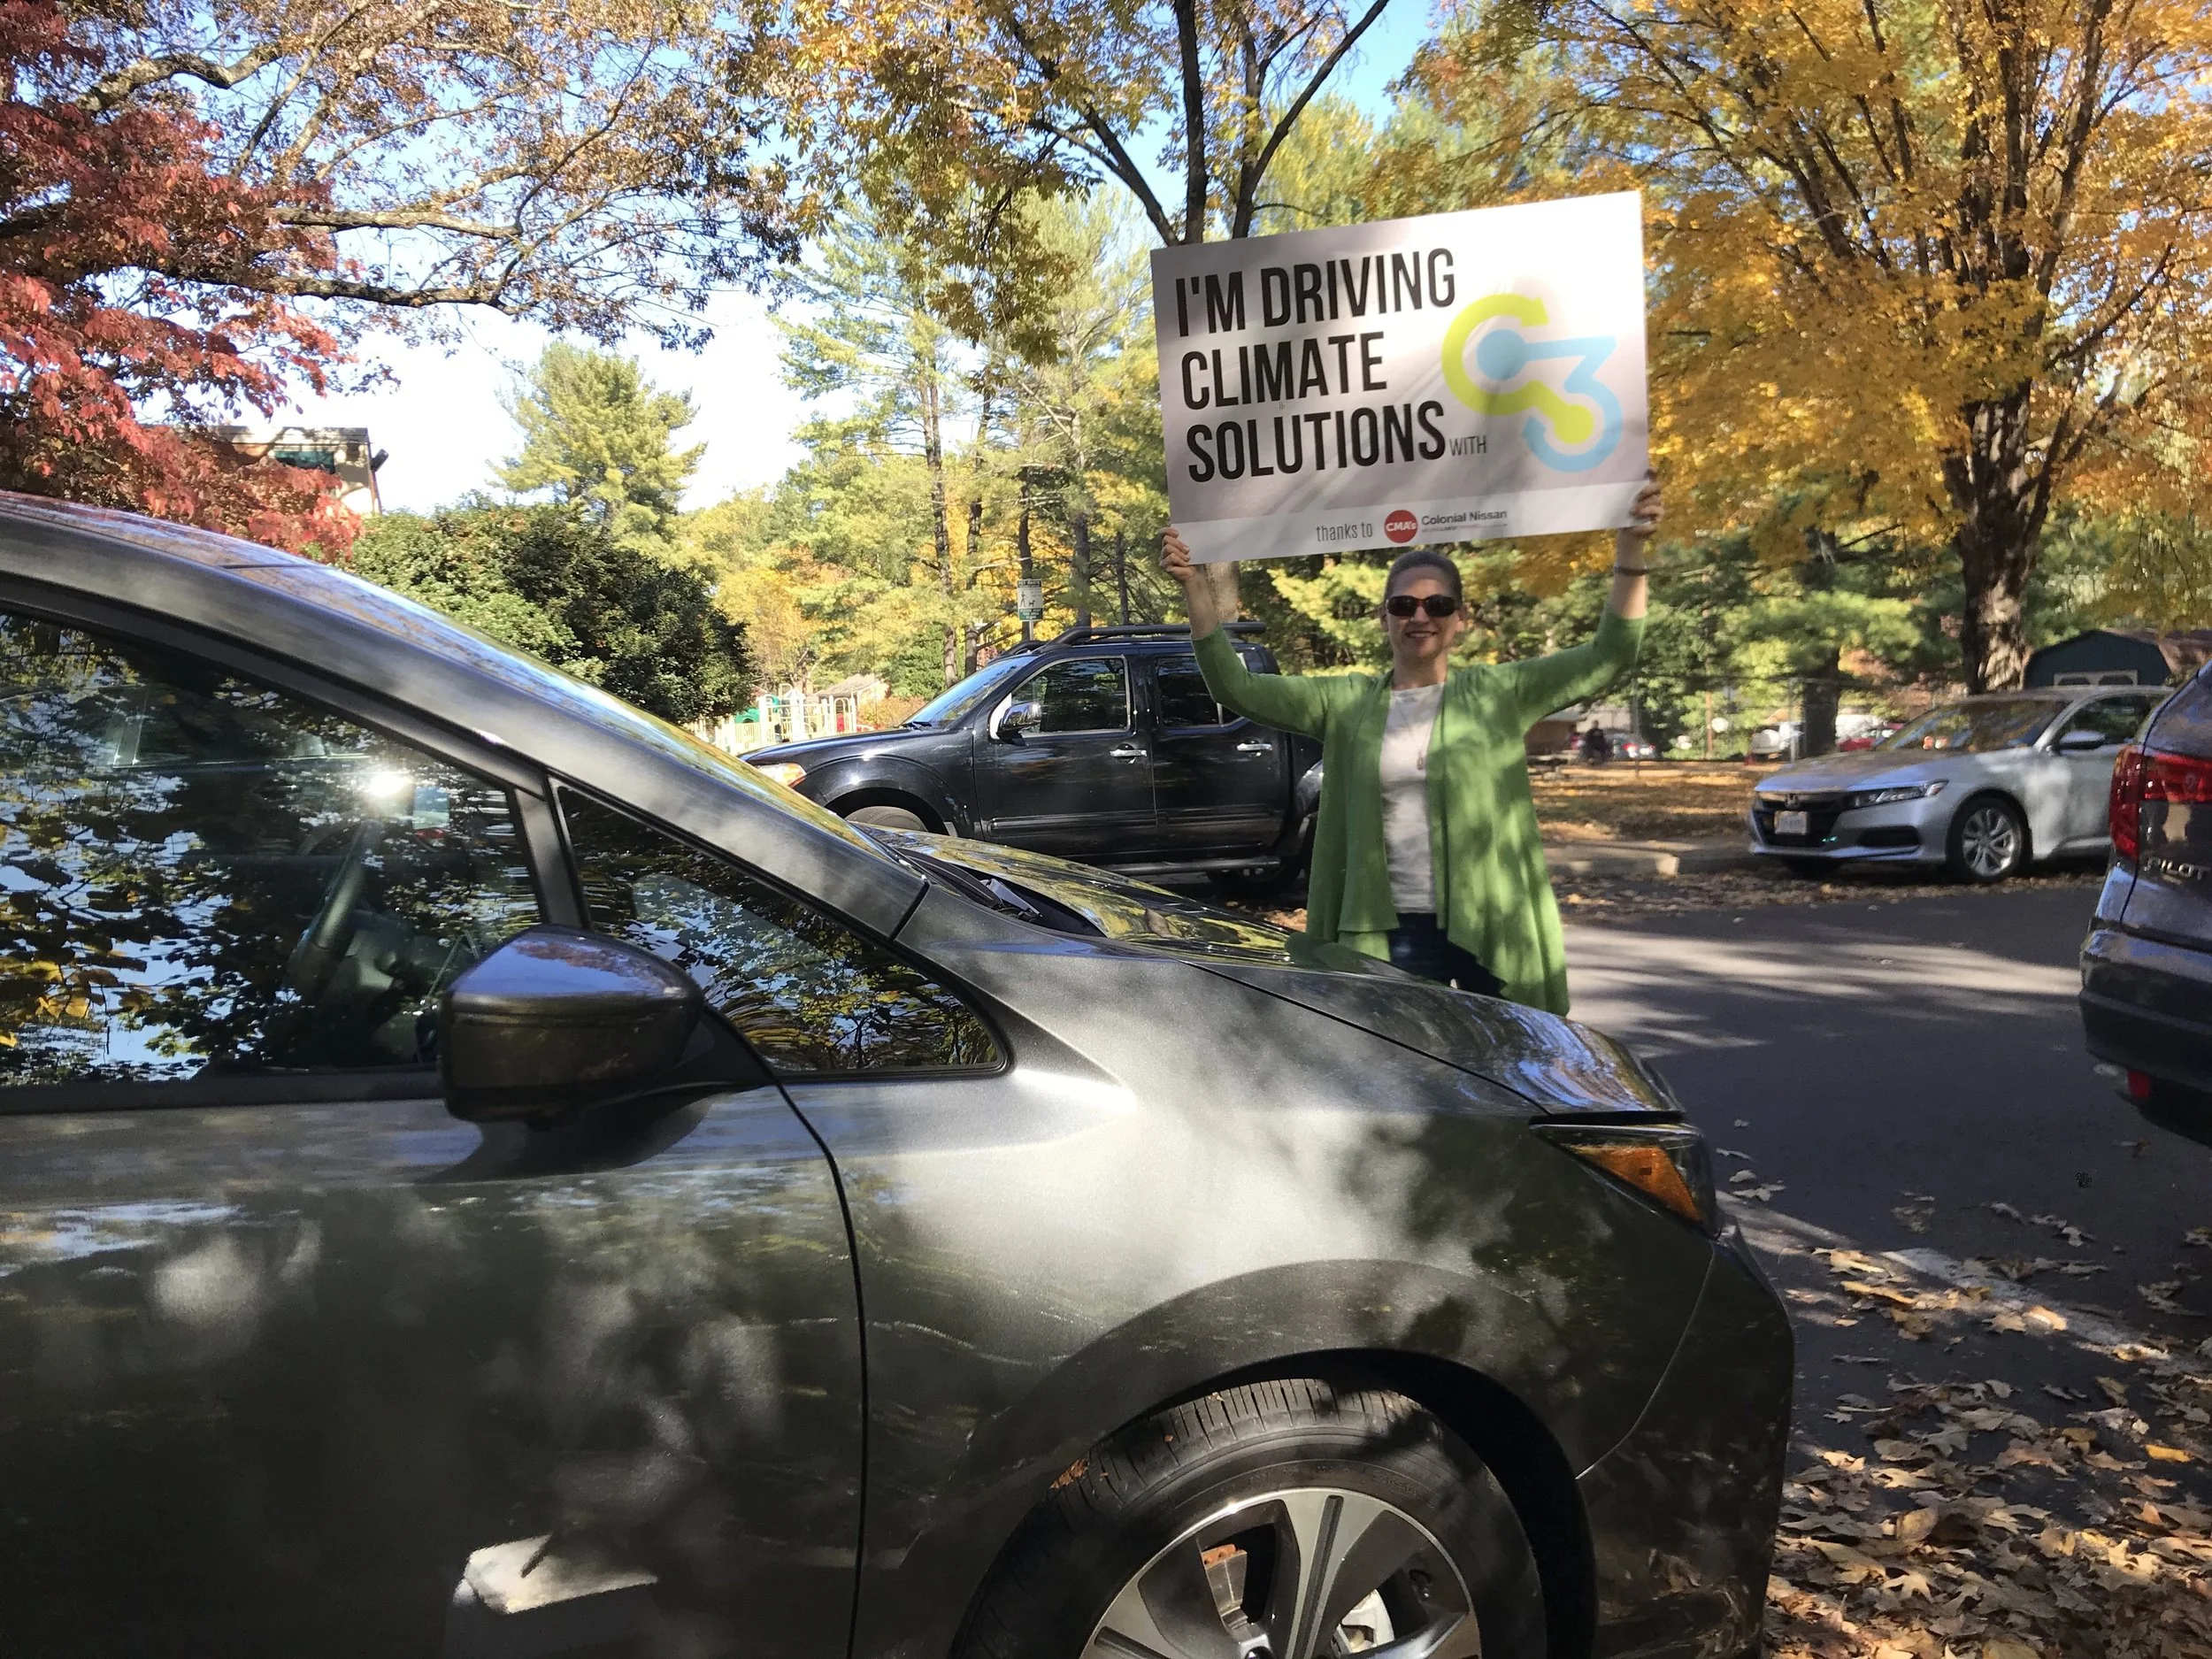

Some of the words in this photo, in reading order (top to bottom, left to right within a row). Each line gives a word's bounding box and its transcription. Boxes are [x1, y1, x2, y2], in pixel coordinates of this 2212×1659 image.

[1175, 271, 1246, 337] I'M
[1260, 248, 1455, 327] DRIVING
[1181, 331, 1387, 410] CLIMATE
[1187, 401, 1446, 482] SOLUTIONS
[1448, 434, 1486, 457] WITH
[1316, 523, 1358, 541] thanks
[1361, 521, 1373, 538] to
[1421, 512, 1467, 526] Colonial
[1469, 511, 1507, 521] Nissan
[2144, 856, 2211, 881] PILOT
